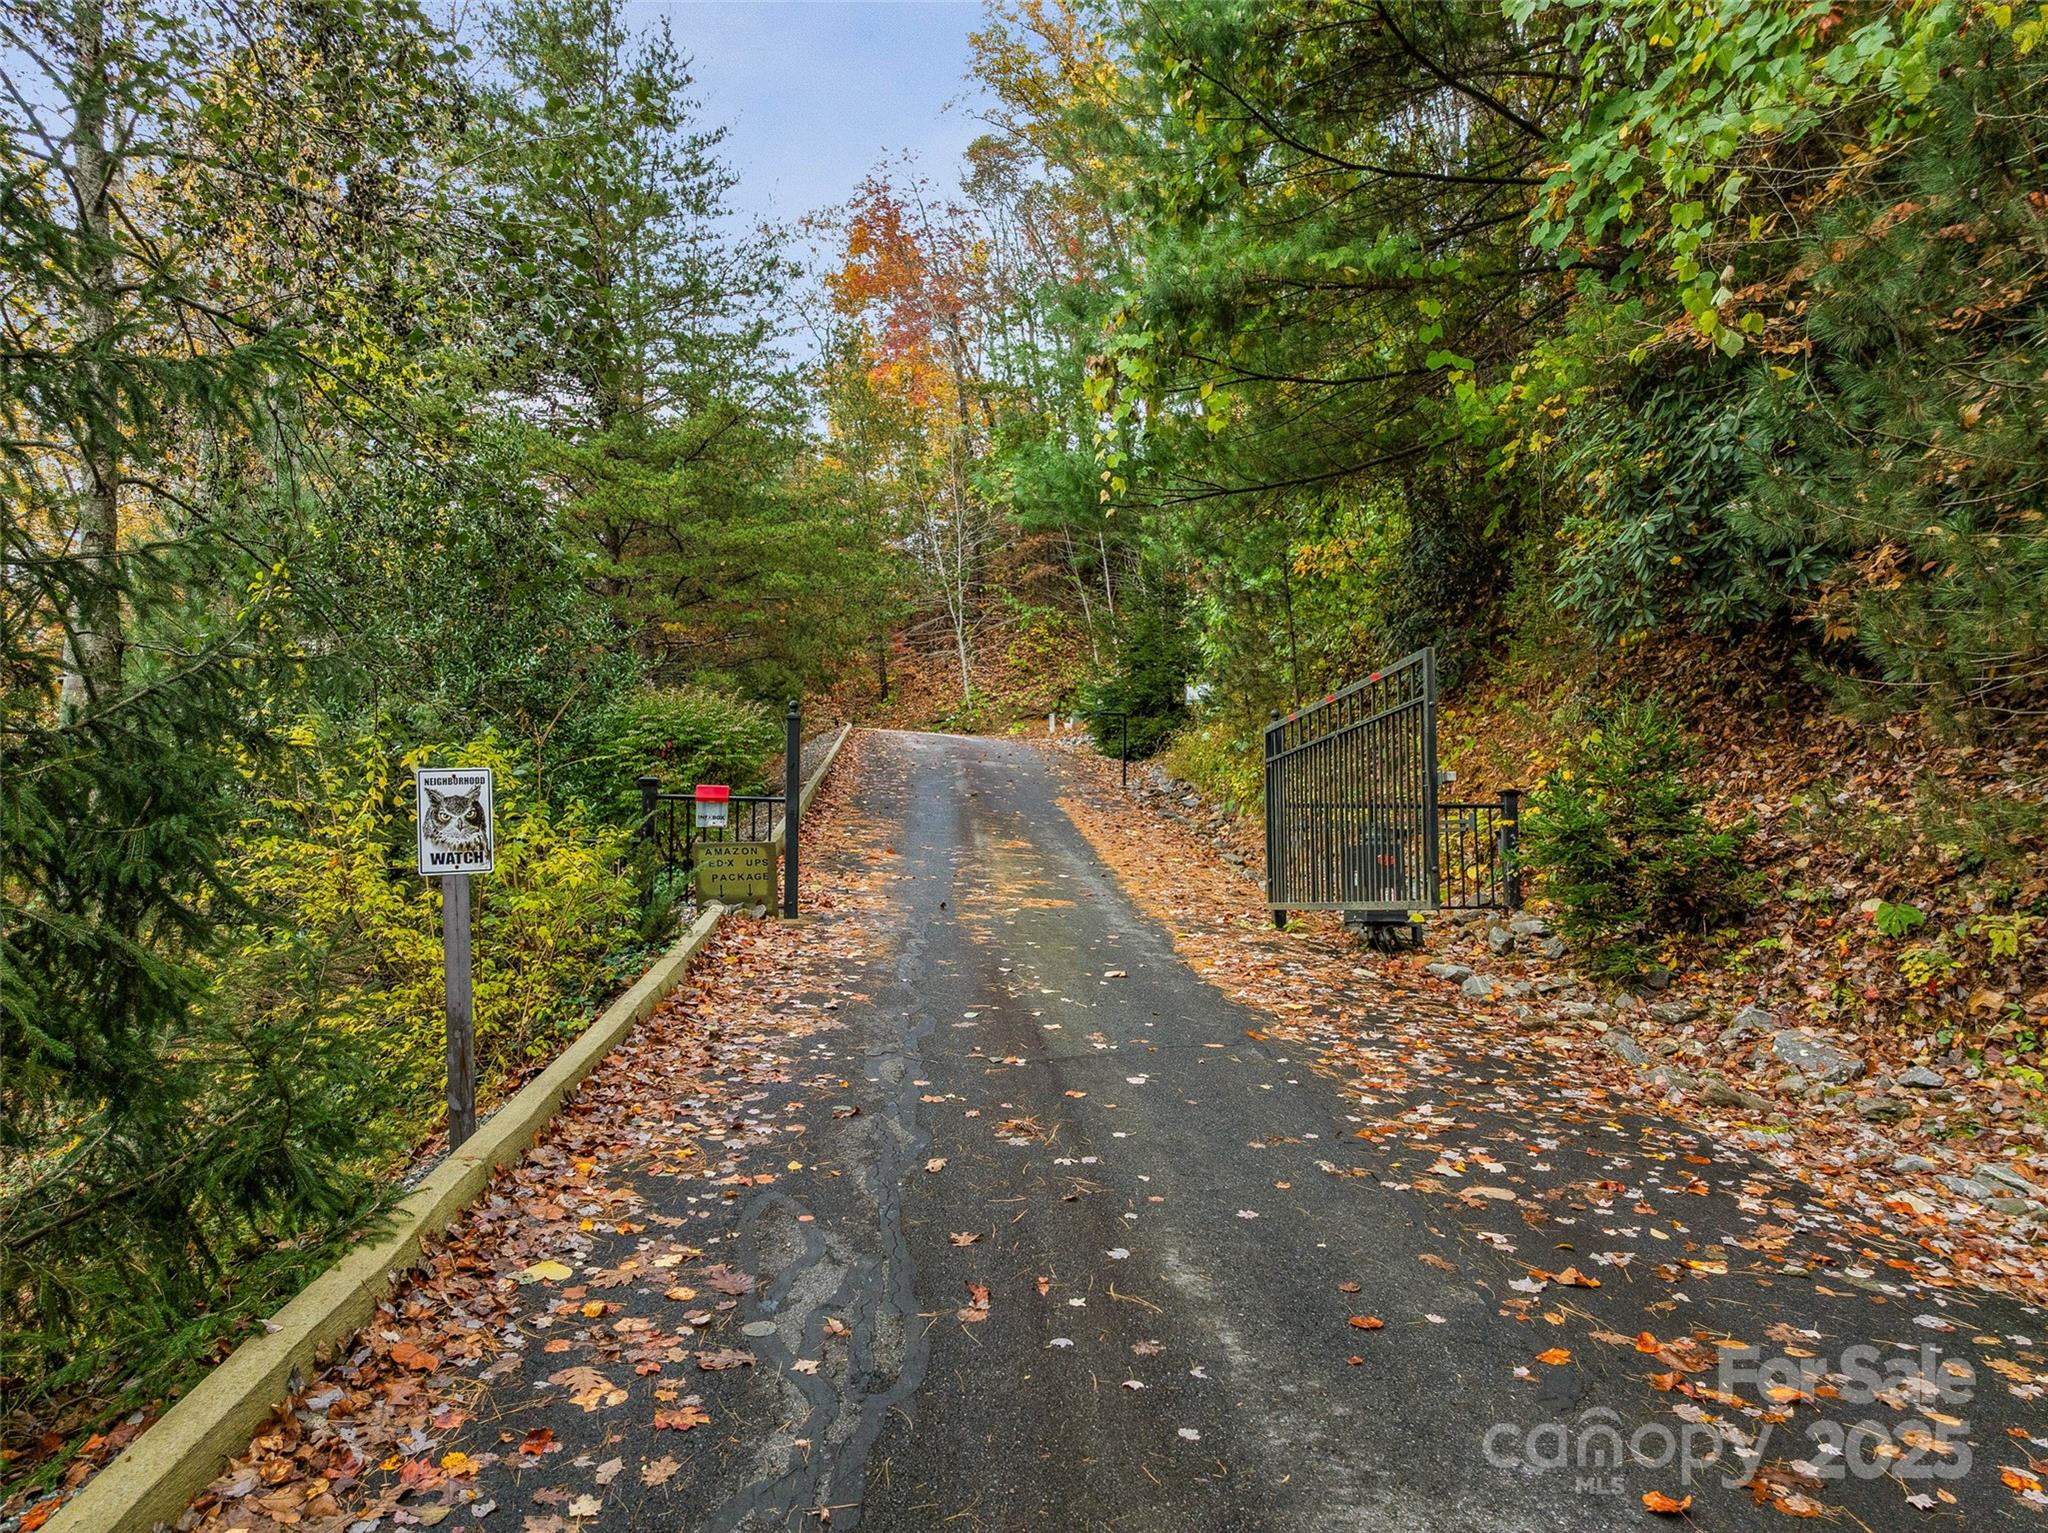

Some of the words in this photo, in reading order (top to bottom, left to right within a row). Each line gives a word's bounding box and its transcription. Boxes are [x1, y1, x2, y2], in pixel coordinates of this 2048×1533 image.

[424, 777, 485, 786] NEIGHBORHOOD
[430, 852, 483, 865] WATCH
[712, 873, 769, 882] PACKAGE
